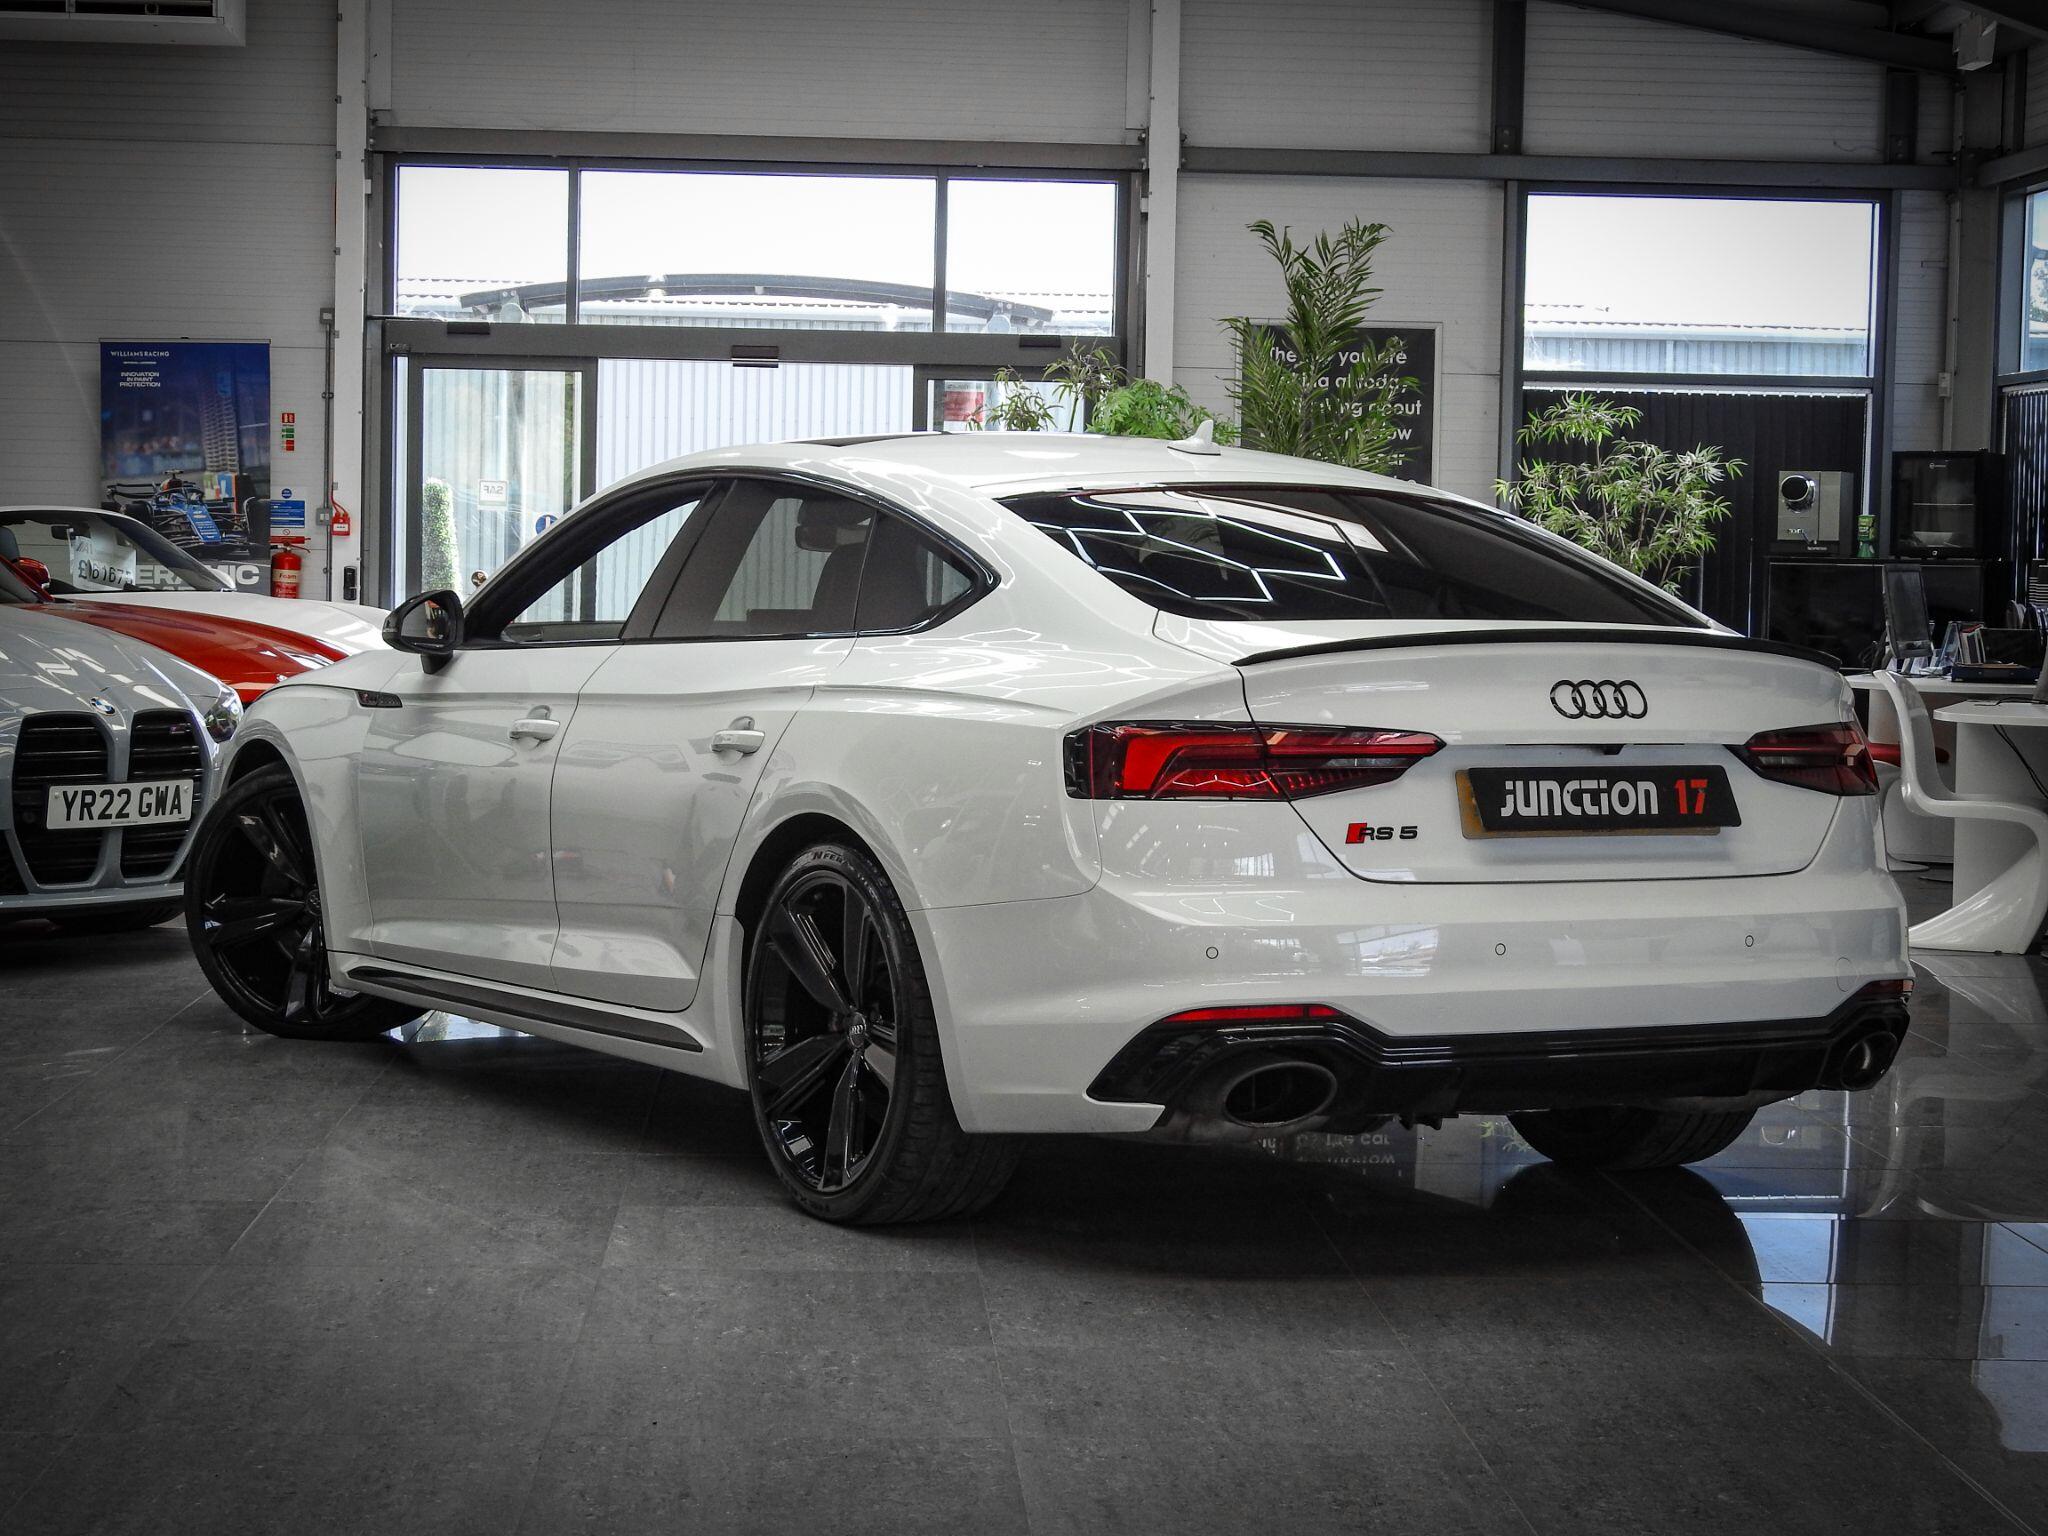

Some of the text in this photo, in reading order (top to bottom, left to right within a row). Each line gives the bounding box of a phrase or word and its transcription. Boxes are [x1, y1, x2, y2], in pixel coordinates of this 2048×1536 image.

[62, 784, 182, 821] YR22 GWA
[1674, 779, 1708, 815] 17
[1358, 825, 1418, 841] RS 5
